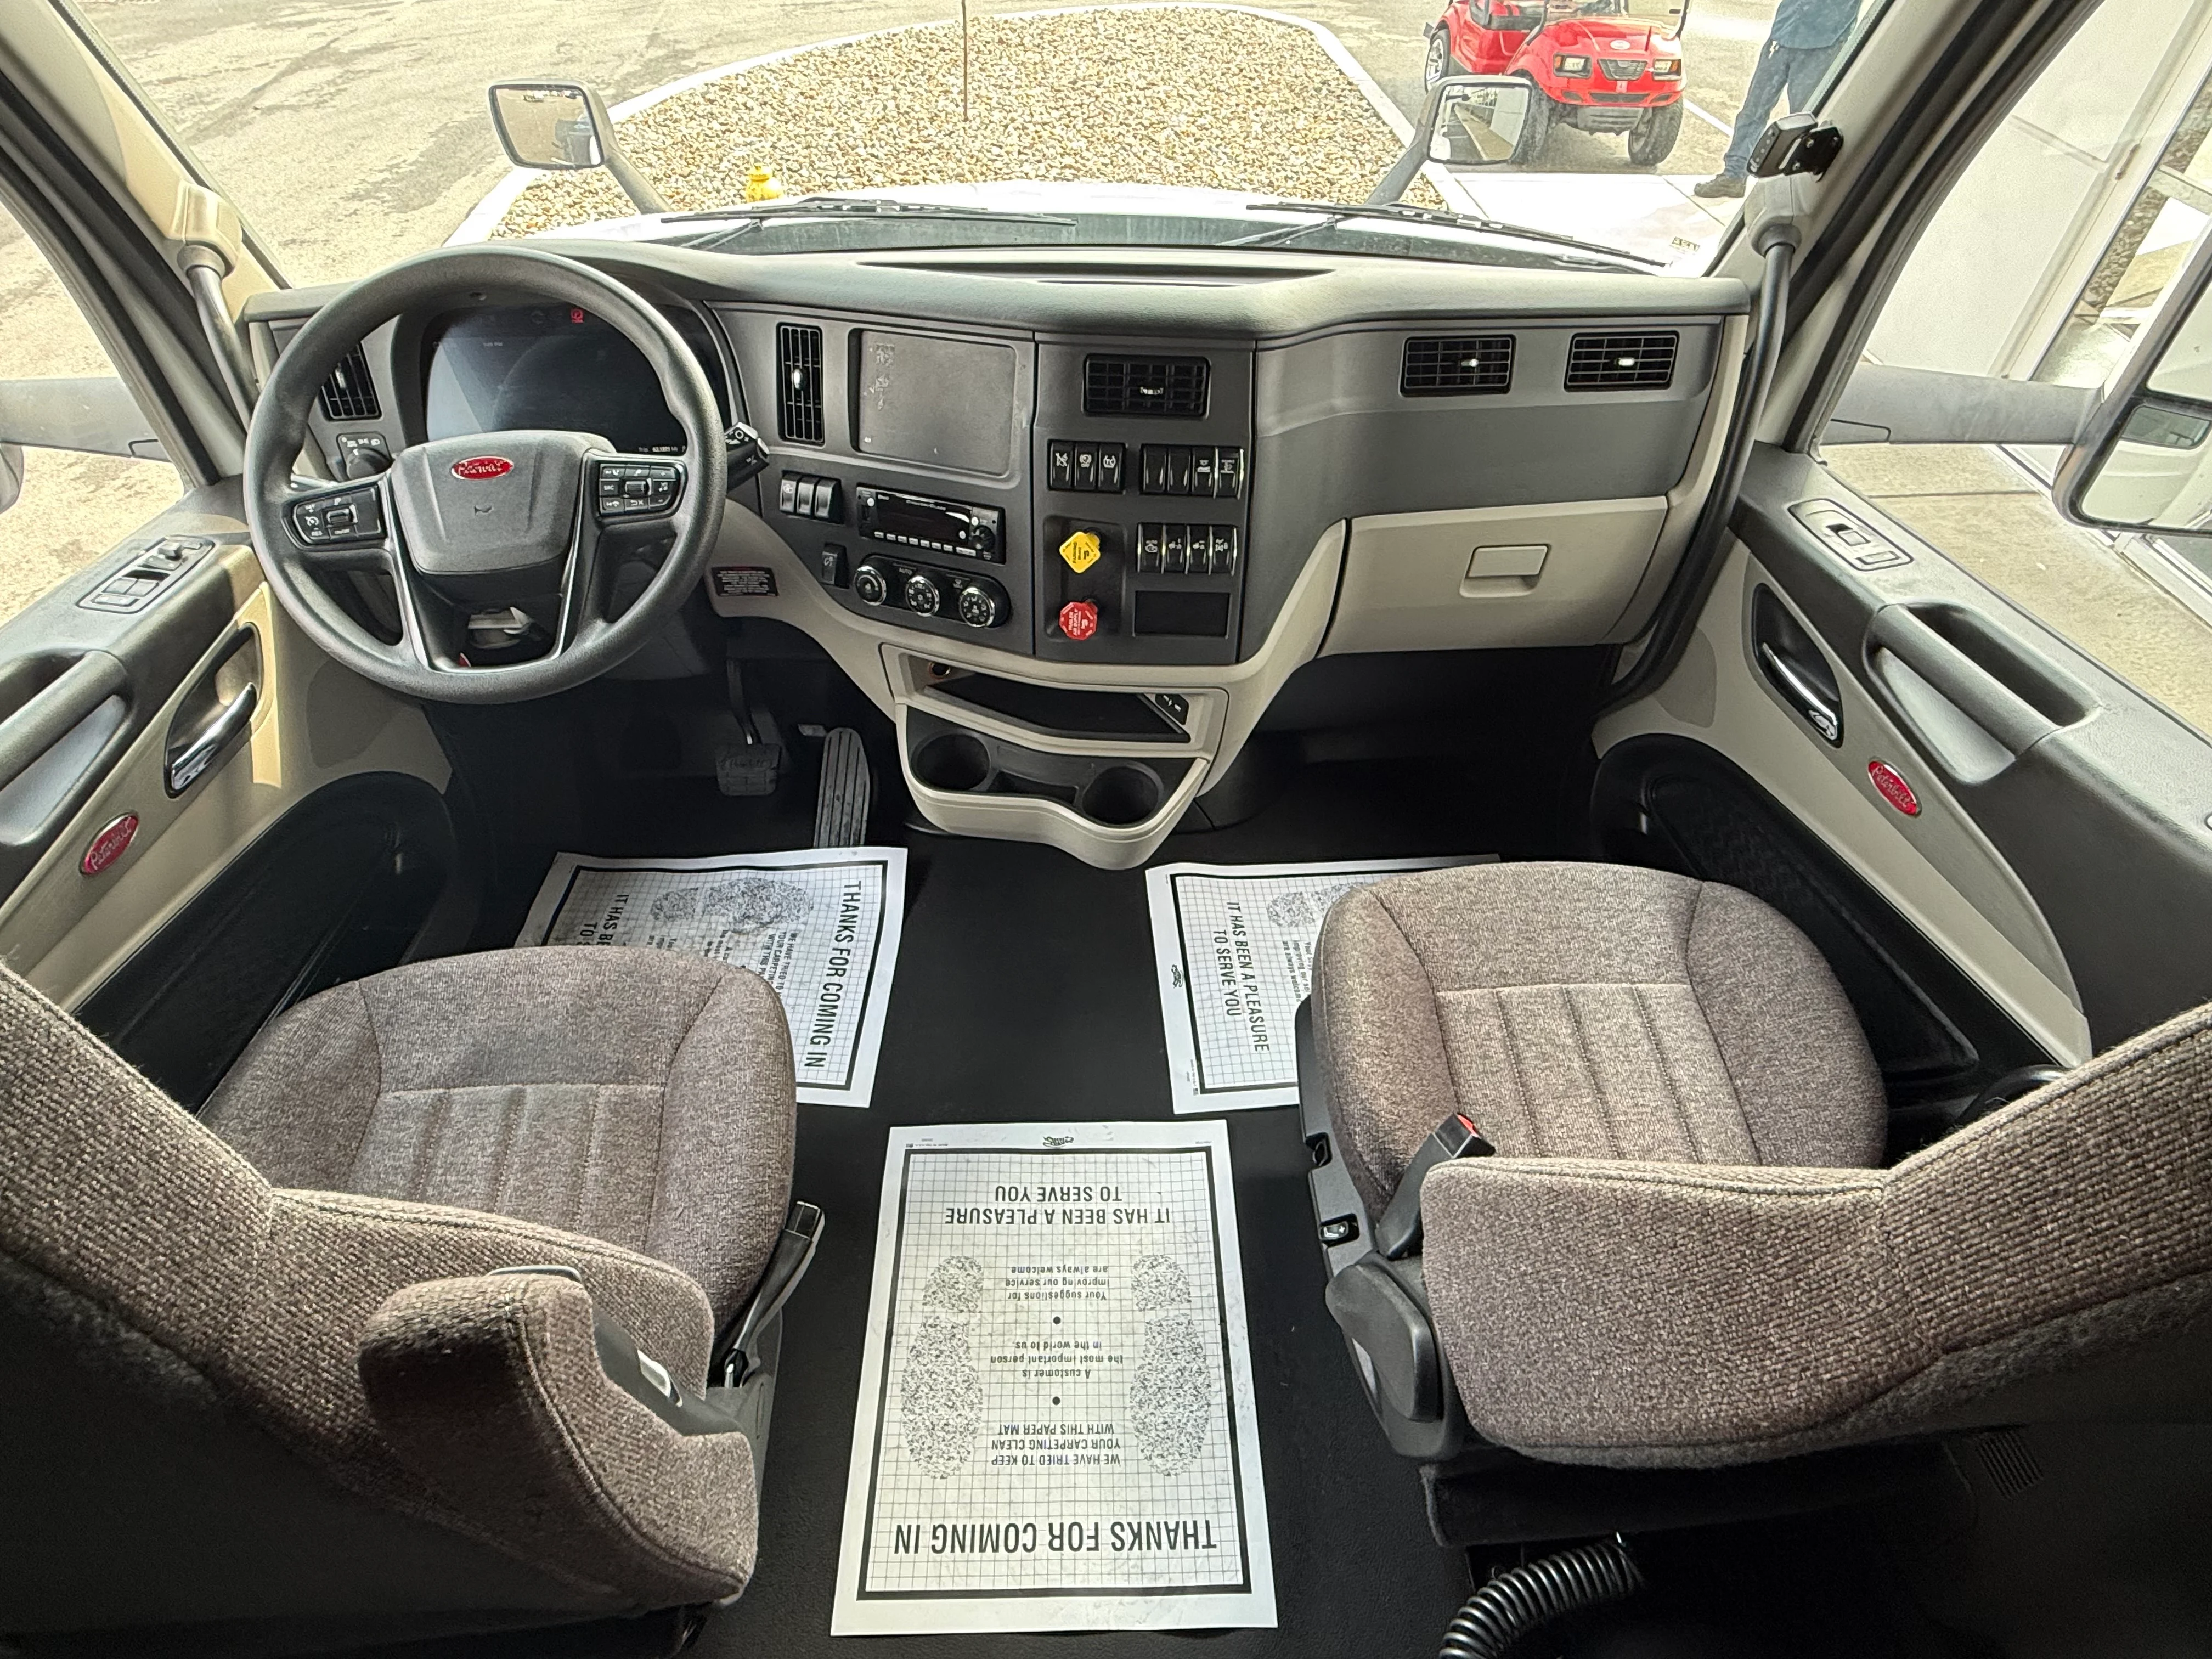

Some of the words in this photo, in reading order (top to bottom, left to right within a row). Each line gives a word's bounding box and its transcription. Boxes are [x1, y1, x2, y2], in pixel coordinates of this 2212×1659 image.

[899, 567, 912, 575] AUTO
[1872, 766, 1911, 808] Peterbilt
[614, 894, 630, 904] IT
[834, 881, 861, 943] THANKS
[1226, 902, 1241, 912] IT
[603, 907, 624, 930] HAS
[580, 922, 597, 936] TO
[1229, 915, 1246, 937] HAS
[764, 934, 776, 950] WITH
[776, 932, 787, 948] YOUR
[1213, 929, 1228, 944] TO
[783, 943, 794, 960] HAVE
[1235, 940, 1254, 969] BEEN
[760, 951, 771, 965] THIS
[826, 947, 851, 977] FOR
[1285, 952, 1295, 973] always
[778, 961, 790, 980] TRIED
[1216, 948, 1237, 986] SERVE
[1224, 990, 1242, 1015] YOU
[810, 982, 843, 1046] COMING
[1243, 984, 1269, 1052] PLEASURE
[804, 1052, 827, 1068] IN
[995, 1186, 1030, 1202] YOU
[1037, 1186, 1093, 1201] SERVE
[1100, 1186, 1122, 1201] TO
[945, 1207, 1036, 1224] PLEASURE
[1045, 1209, 1055, 1224] A
[1063, 1208, 1106, 1224] BEEN
[1114, 1208, 1148, 1224] HAS
[1155, 1207, 1170, 1223] IT
[1011, 1266, 1053, 1274] welcome
[1057, 1265, 1089, 1274] always
[1005, 1278, 1040, 1288] service
[1008, 1291, 1021, 1301] for
[1024, 1290, 1082, 1301] suggestions
[1085, 1291, 1107, 1301] Your
[1030, 1341, 1040, 1351] to
[1043, 1341, 1070, 1350] world
[1074, 1341, 1089, 1350] the
[1093, 1341, 1102, 1350] in
[991, 1353, 1024, 1363] person
[1028, 1353, 1076, 1365] important
[1080, 1355, 1104, 1364] most
[1108, 1355, 1123, 1364] the
[1022, 1369, 1030, 1379] is
[1034, 1369, 1081, 1378] customer
[1085, 1369, 1091, 1379] A
[997, 1424, 1019, 1435] MAT
[1023, 1424, 1056, 1435] PAPER
[1060, 1423, 1084, 1435] THIS
[1087, 1423, 1114, 1434] WITH
[991, 1439, 1025, 1450] CLEAN
[1029, 1438, 1087, 1449] CARPETING
[1091, 1438, 1121, 1449] YOUR
[991, 1455, 1018, 1465] KEEP
[1022, 1455, 1035, 1465] TO
[1039, 1454, 1069, 1465] TRIED
[1073, 1454, 1100, 1466] HAVE
[1104, 1454, 1121, 1466] WE
[894, 1523, 919, 1555] IN
[931, 1523, 1037, 1555] COMING
[1048, 1521, 1099, 1552] FOR
[1110, 1520, 1217, 1551] THANKS
